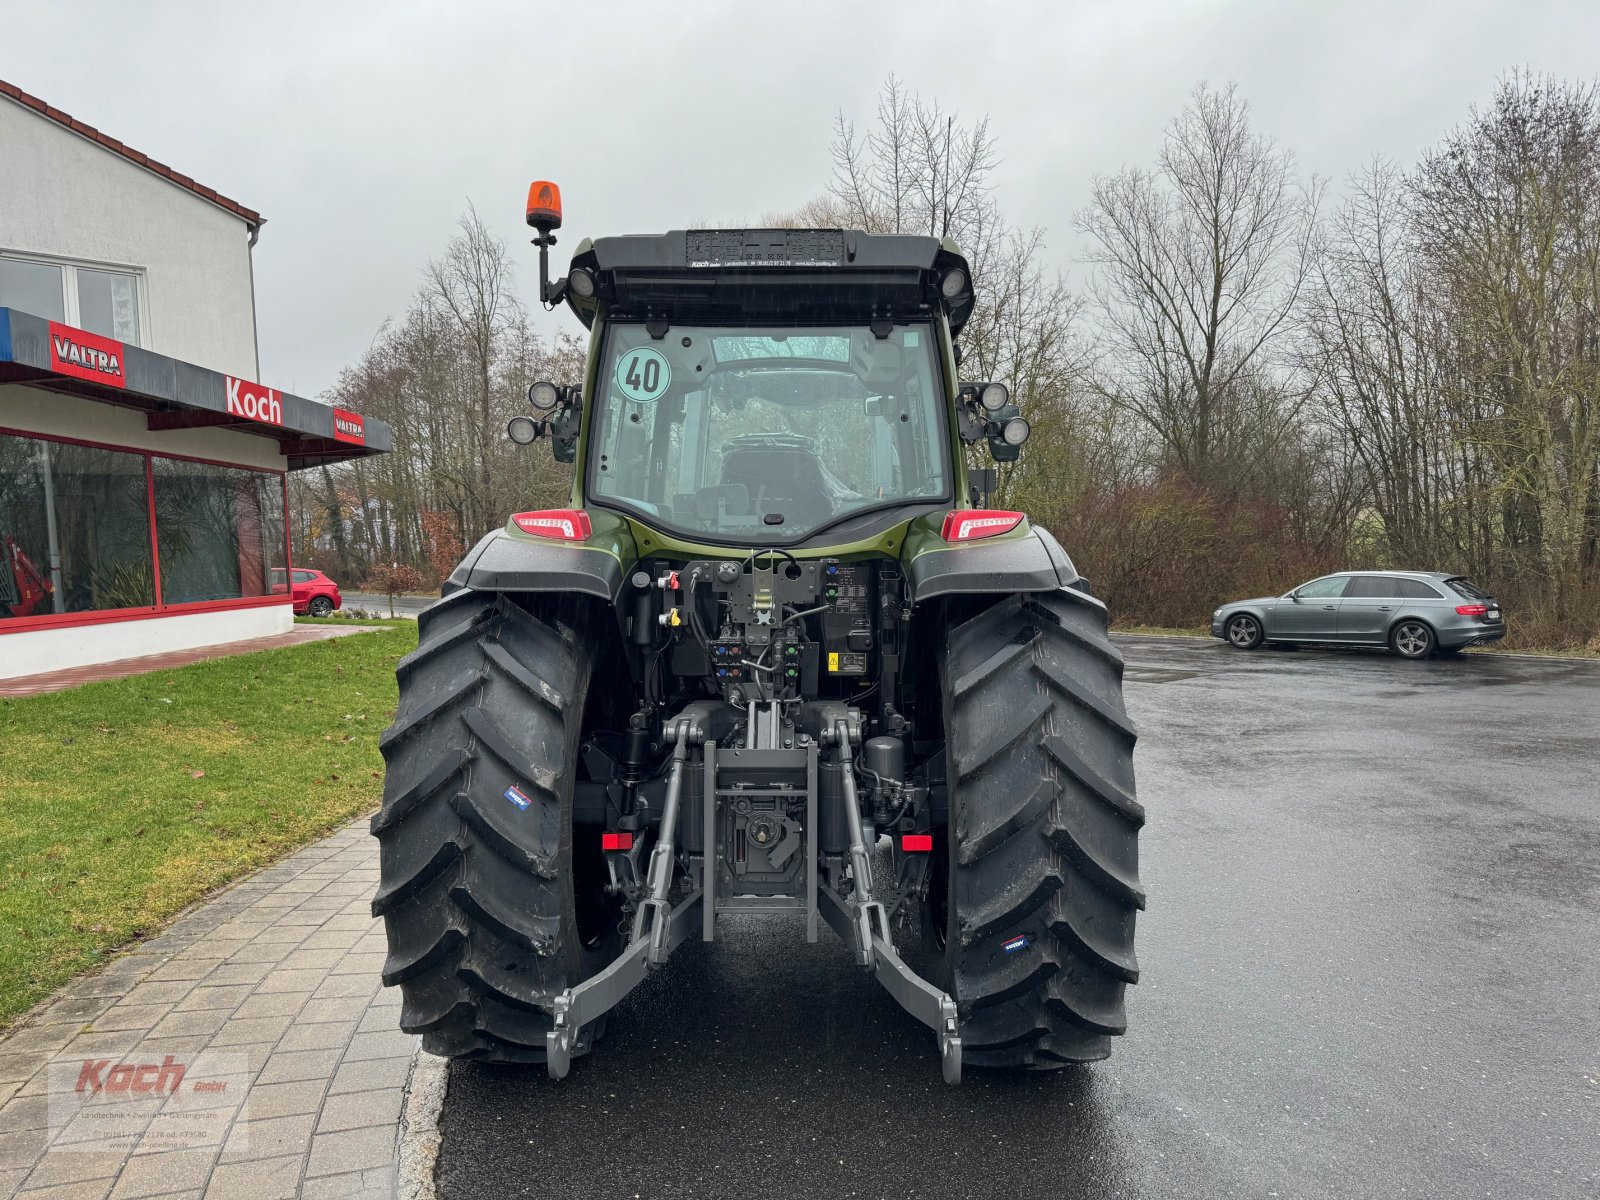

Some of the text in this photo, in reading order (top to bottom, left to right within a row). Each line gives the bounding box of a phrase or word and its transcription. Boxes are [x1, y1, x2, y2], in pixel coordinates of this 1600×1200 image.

[691, 260, 710, 268] Koch
[52, 333, 122, 377] VALTRA
[625, 356, 660, 393] 40
[225, 375, 282, 424] Koch
[335, 416, 363, 438] VALTRA
